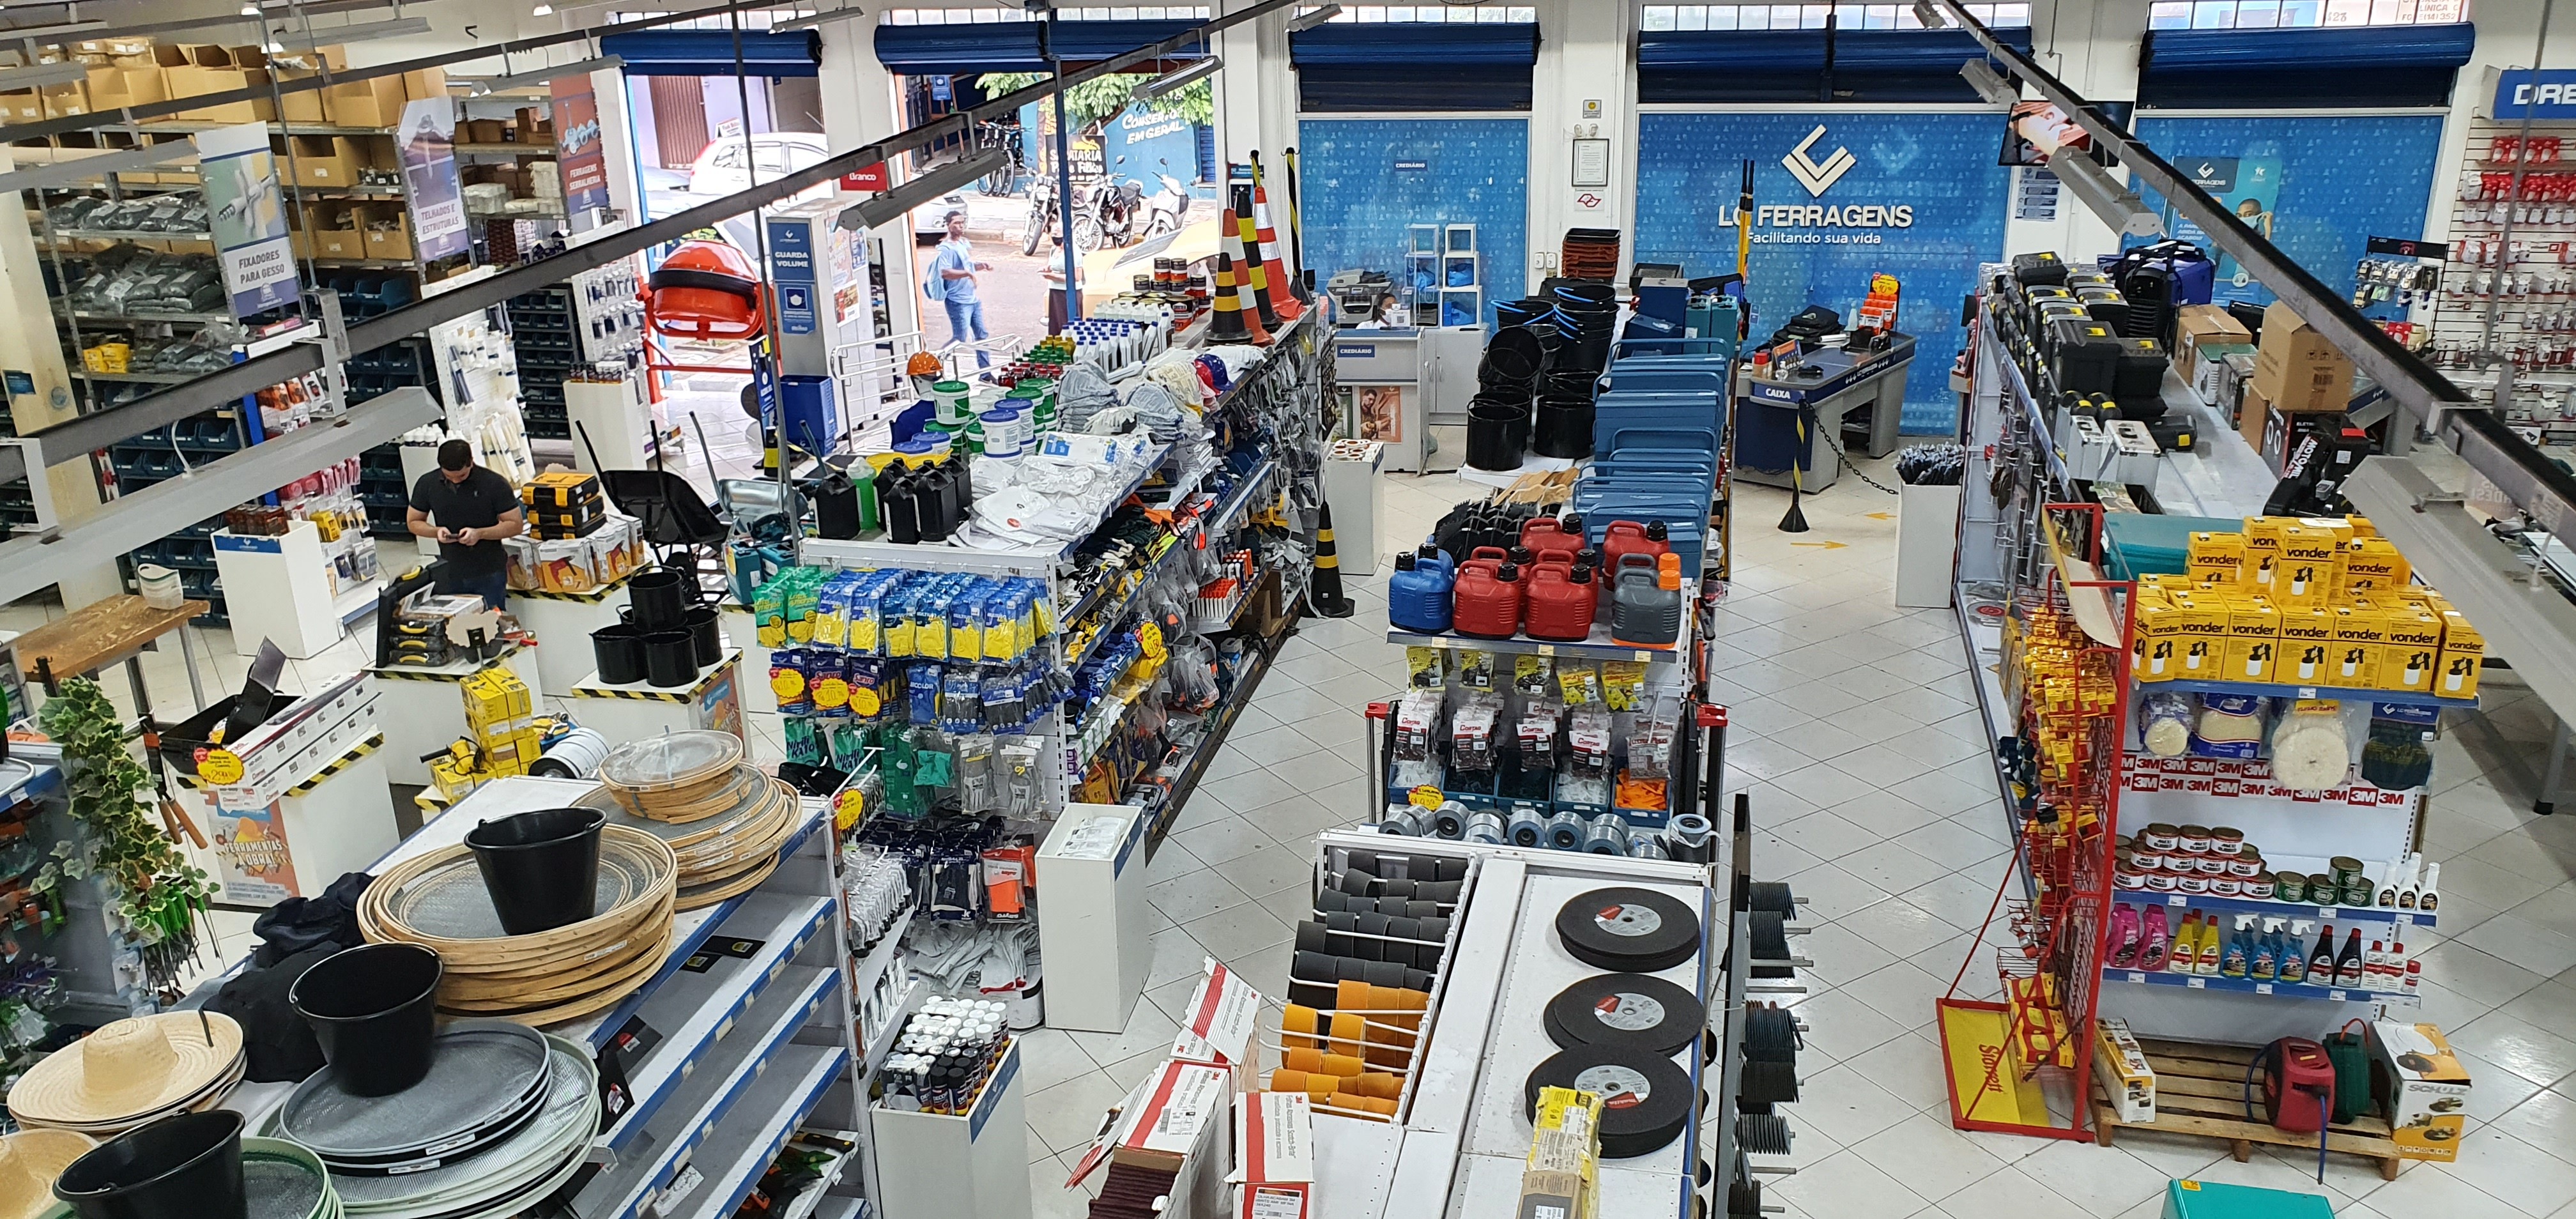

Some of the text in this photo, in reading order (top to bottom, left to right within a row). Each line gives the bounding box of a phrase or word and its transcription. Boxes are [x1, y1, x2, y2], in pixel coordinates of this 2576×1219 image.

[1122, 108, 1180, 130] CONSERO
[1126, 121, 1186, 145] EM GERAL
[1050, 149, 1103, 162] SATARIA
[451, 203, 456, 213] E
[1757, 204, 1913, 227] FERRAGENS
[1824, 234, 1848, 244] sua
[1852, 231, 1882, 244] vida
[238, 249, 280, 270] FIXADORES
[240, 263, 285, 284] PARA GESSO
[1765, 388, 1791, 399] CAIXA
[2253, 536, 2276, 547] von
[2287, 547, 2332, 559] vonder
[2197, 554, 2237, 565] vonder
[2347, 563, 2393, 574] vonder
[2152, 625, 2180, 634] vonder
[2181, 622, 2225, 634] vonder
[2232, 624, 2276, 635] vonder
[2285, 626, 2329, 638] vonder
[2337, 628, 2383, 641] vonder
[2389, 632, 2437, 644] vonder
[2448, 641, 2483, 650] vonder
[815, 671, 841, 679] Sanro
[853, 673, 875, 684] Sanro
[910, 681, 934, 689] BICOLOR
[2136, 758, 2161, 770] 3M
[2162, 758, 2187, 770] 3M
[2189, 760, 2214, 772] 3M
[2217, 762, 2241, 774] 3M
[2243, 763, 2270, 776] 3M
[2133, 777, 2158, 788] 3M
[2160, 778, 2184, 790] 3M
[2187, 780, 2211, 792] 3M
[2214, 782, 2239, 793] 3M
[2241, 784, 2266, 795] 3M
[2267, 786, 2292, 797] 3M
[2294, 790, 2320, 800] 3M
[2323, 790, 2348, 801] 3M
[2350, 791, 2377, 803] 3M
[2379, 793, 2405, 805] 3M
[224, 839, 283, 854] FERRAMENTAS
[238, 852, 278, 866] A OBRA!
[1211, 1071, 1220, 1080] 3M
[2407, 1084, 2468, 1096] SCHULZ
[1296, 1095, 1303, 1104] 3M
